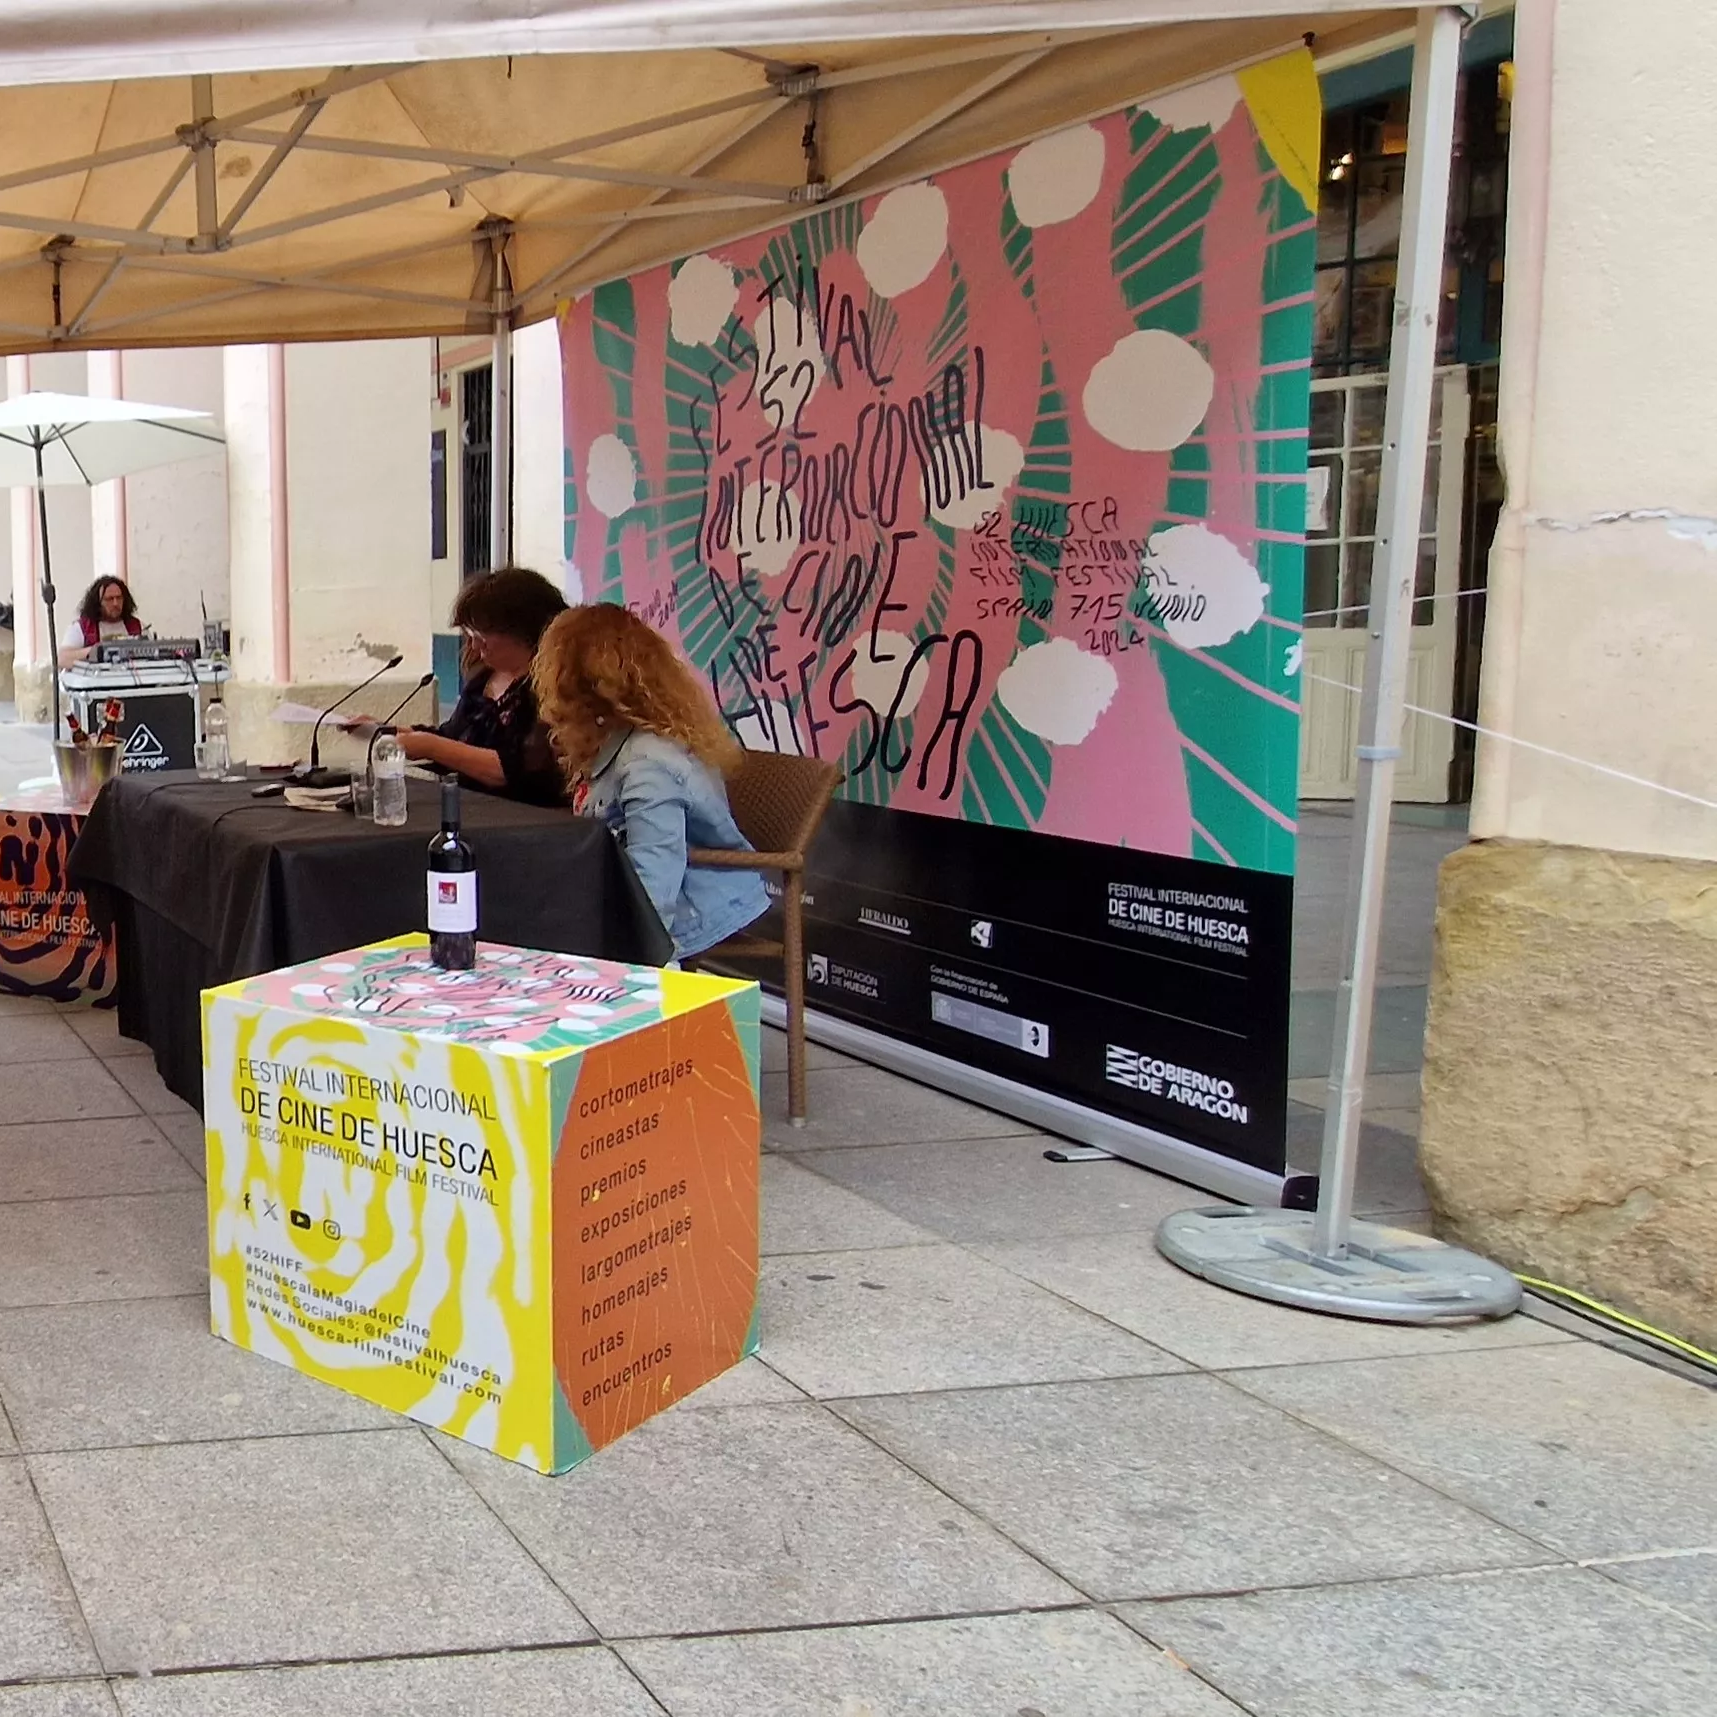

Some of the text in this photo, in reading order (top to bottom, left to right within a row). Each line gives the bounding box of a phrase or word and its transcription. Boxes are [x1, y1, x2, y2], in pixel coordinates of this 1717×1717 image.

[755, 359, 817, 450] 52
[973, 496, 1120, 540] 52 HUESCA
[708, 551, 771, 630] DE
[734, 623, 787, 683] DE
[1084, 628, 1146, 657] 2024
[711, 629, 984, 801] HUESCA
[122, 756, 169, 769] ehringer
[13, 890, 87, 905] INTERNACION
[22, 913, 40, 931] DE
[860, 906, 910, 930] HERALDO
[1108, 882, 1249, 914] FESTIVAL INTERNACIONAL
[1108, 898, 1249, 945] DE CINE DE HUESCA
[1108, 917, 1136, 933] HUESCA
[1194, 936, 1212, 949] FILM
[1214, 940, 1249, 957] FESTIVAL
[830, 974, 879, 998] DE HUESCA
[238, 1058, 497, 1121] FESTIVAL INTERNACIONAL
[579, 1058, 693, 1118] cortometrajes
[1138, 1073, 1163, 1096] DE
[1139, 1056, 1234, 1099] GOBIERNO
[241, 1087, 499, 1181] DE CINE DE HUESCA
[580, 1112, 659, 1160] cineastas
[241, 1122, 500, 1207] HUESCA INTERNATIONAL FILM FESTIVAL
[580, 1158, 647, 1208] premios
[580, 1178, 687, 1244] exposiciones
[246, 1245, 304, 1273] #52HIFF
[581, 1214, 692, 1285] largometrajes
[581, 1265, 668, 1327] homenajes
[246, 1279, 290, 1305] Redes
[363, 1322, 502, 1386] @festivalhuesca
[247, 1297, 503, 1405] www.huesca-filmfestival.com
[582, 1330, 624, 1367] rutas
[582, 1341, 672, 1407] encuentros
